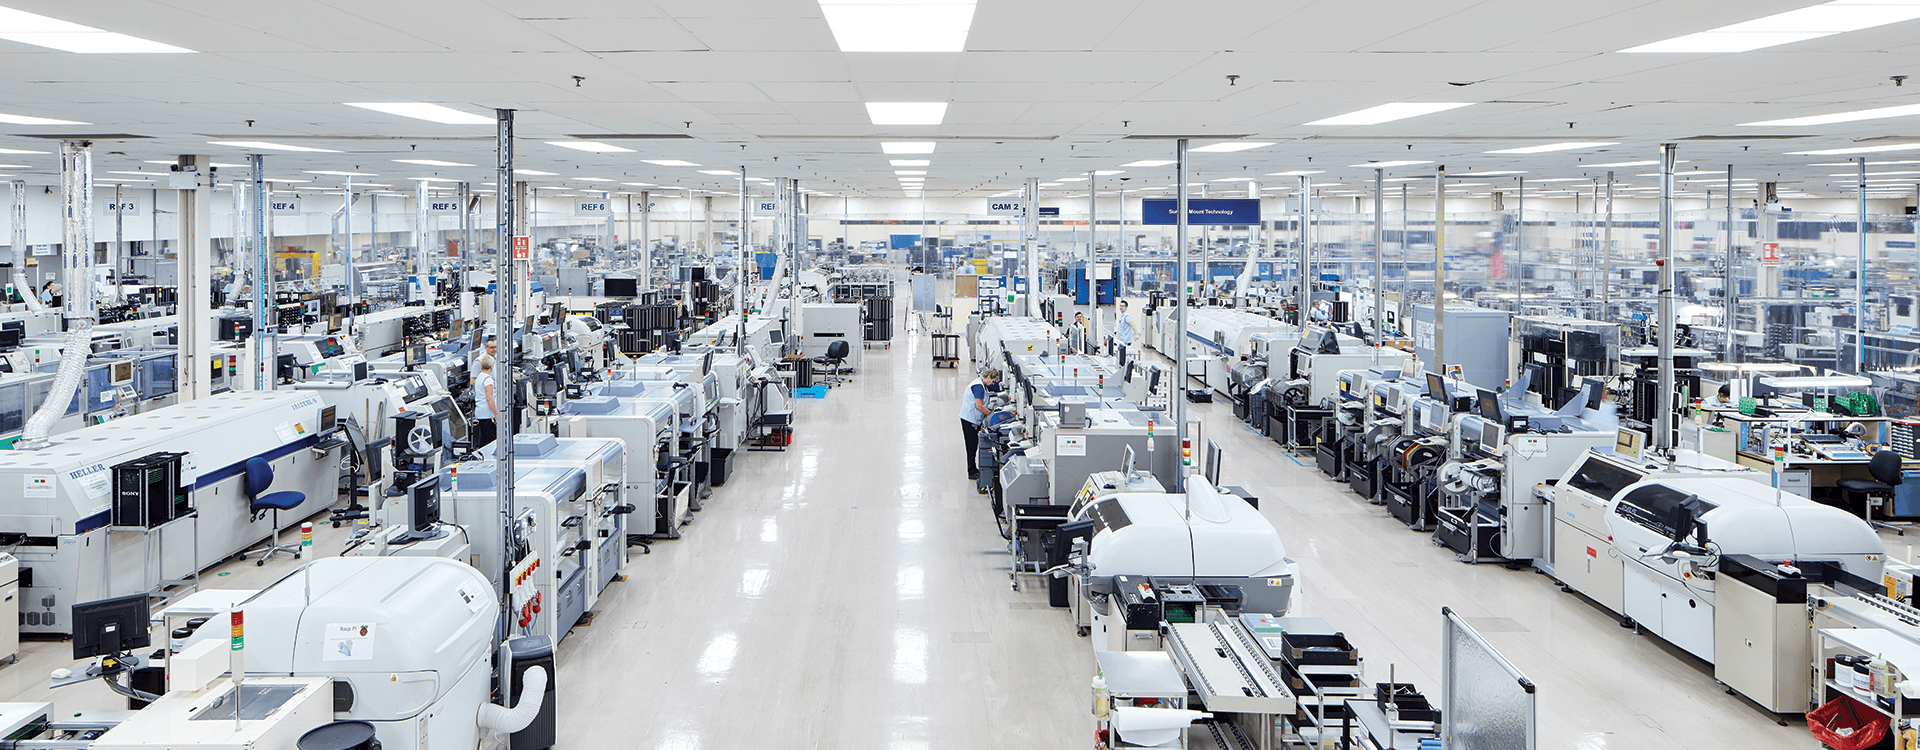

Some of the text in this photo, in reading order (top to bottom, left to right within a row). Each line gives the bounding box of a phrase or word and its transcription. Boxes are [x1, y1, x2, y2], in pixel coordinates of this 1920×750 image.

[581, 203, 605, 211] REF 6
[69, 463, 106, 480] HELLER
